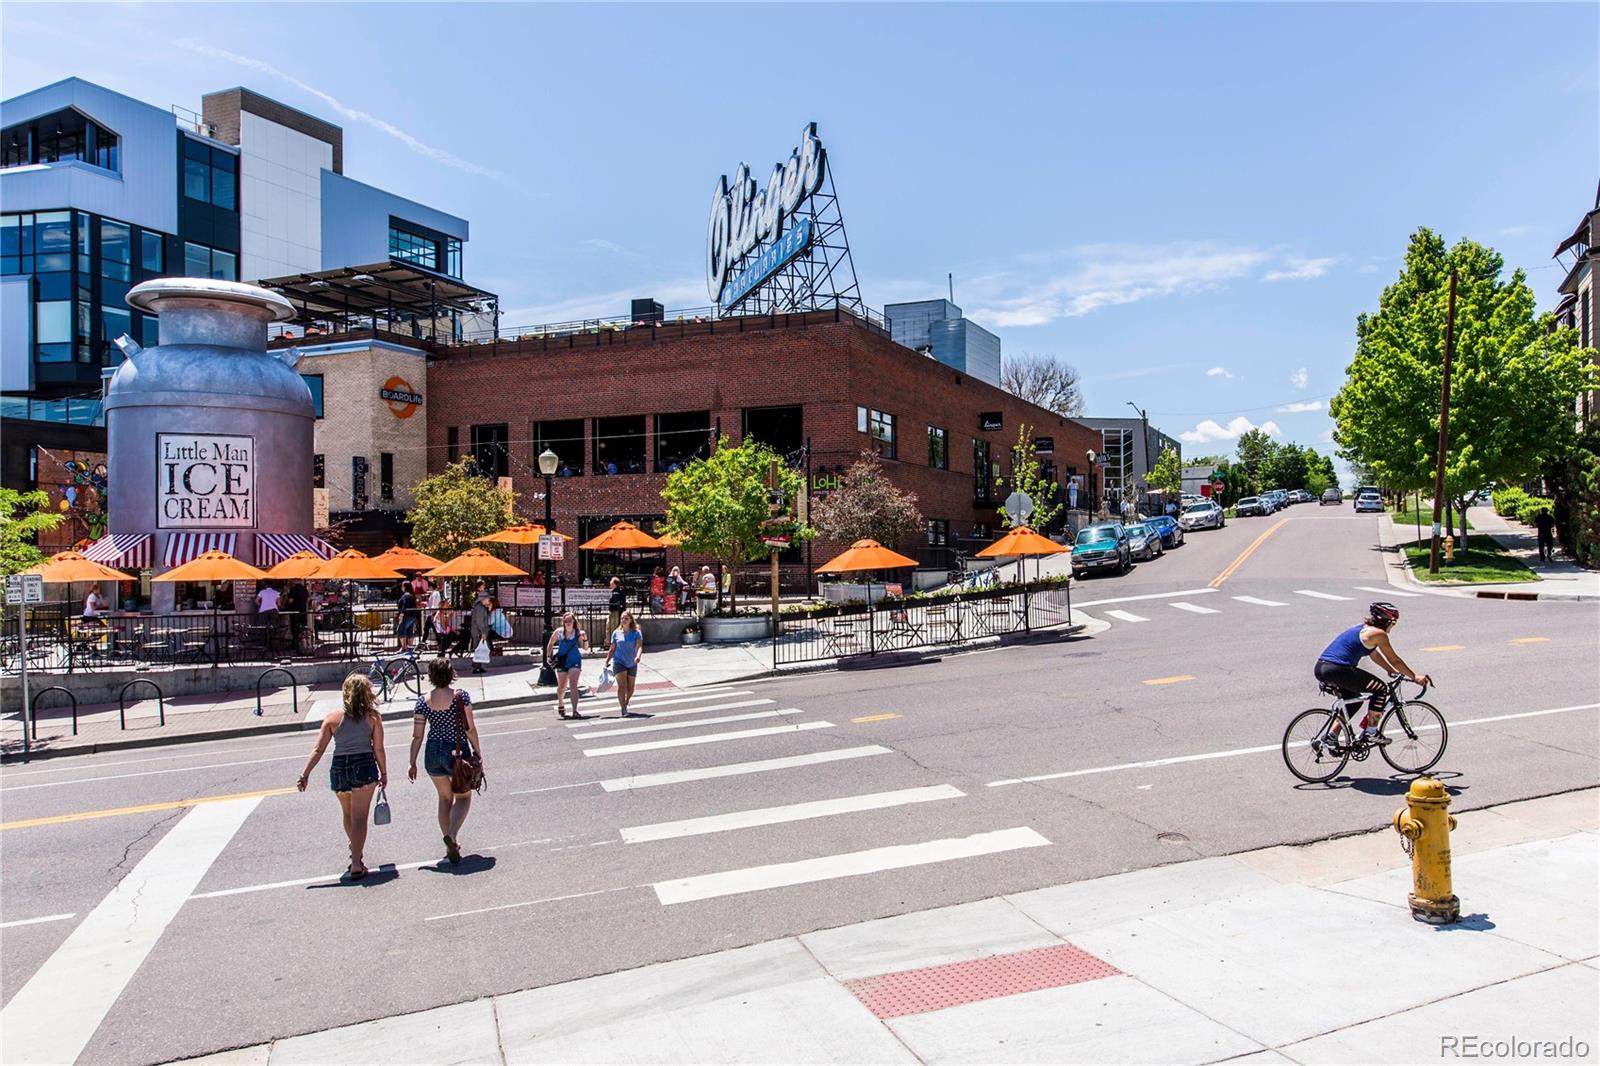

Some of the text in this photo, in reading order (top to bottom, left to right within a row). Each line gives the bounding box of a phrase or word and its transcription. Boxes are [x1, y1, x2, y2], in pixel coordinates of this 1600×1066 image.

[164, 440, 249, 462] Little Man
[164, 462, 250, 496] ICE
[164, 497, 250, 520] CREAM
